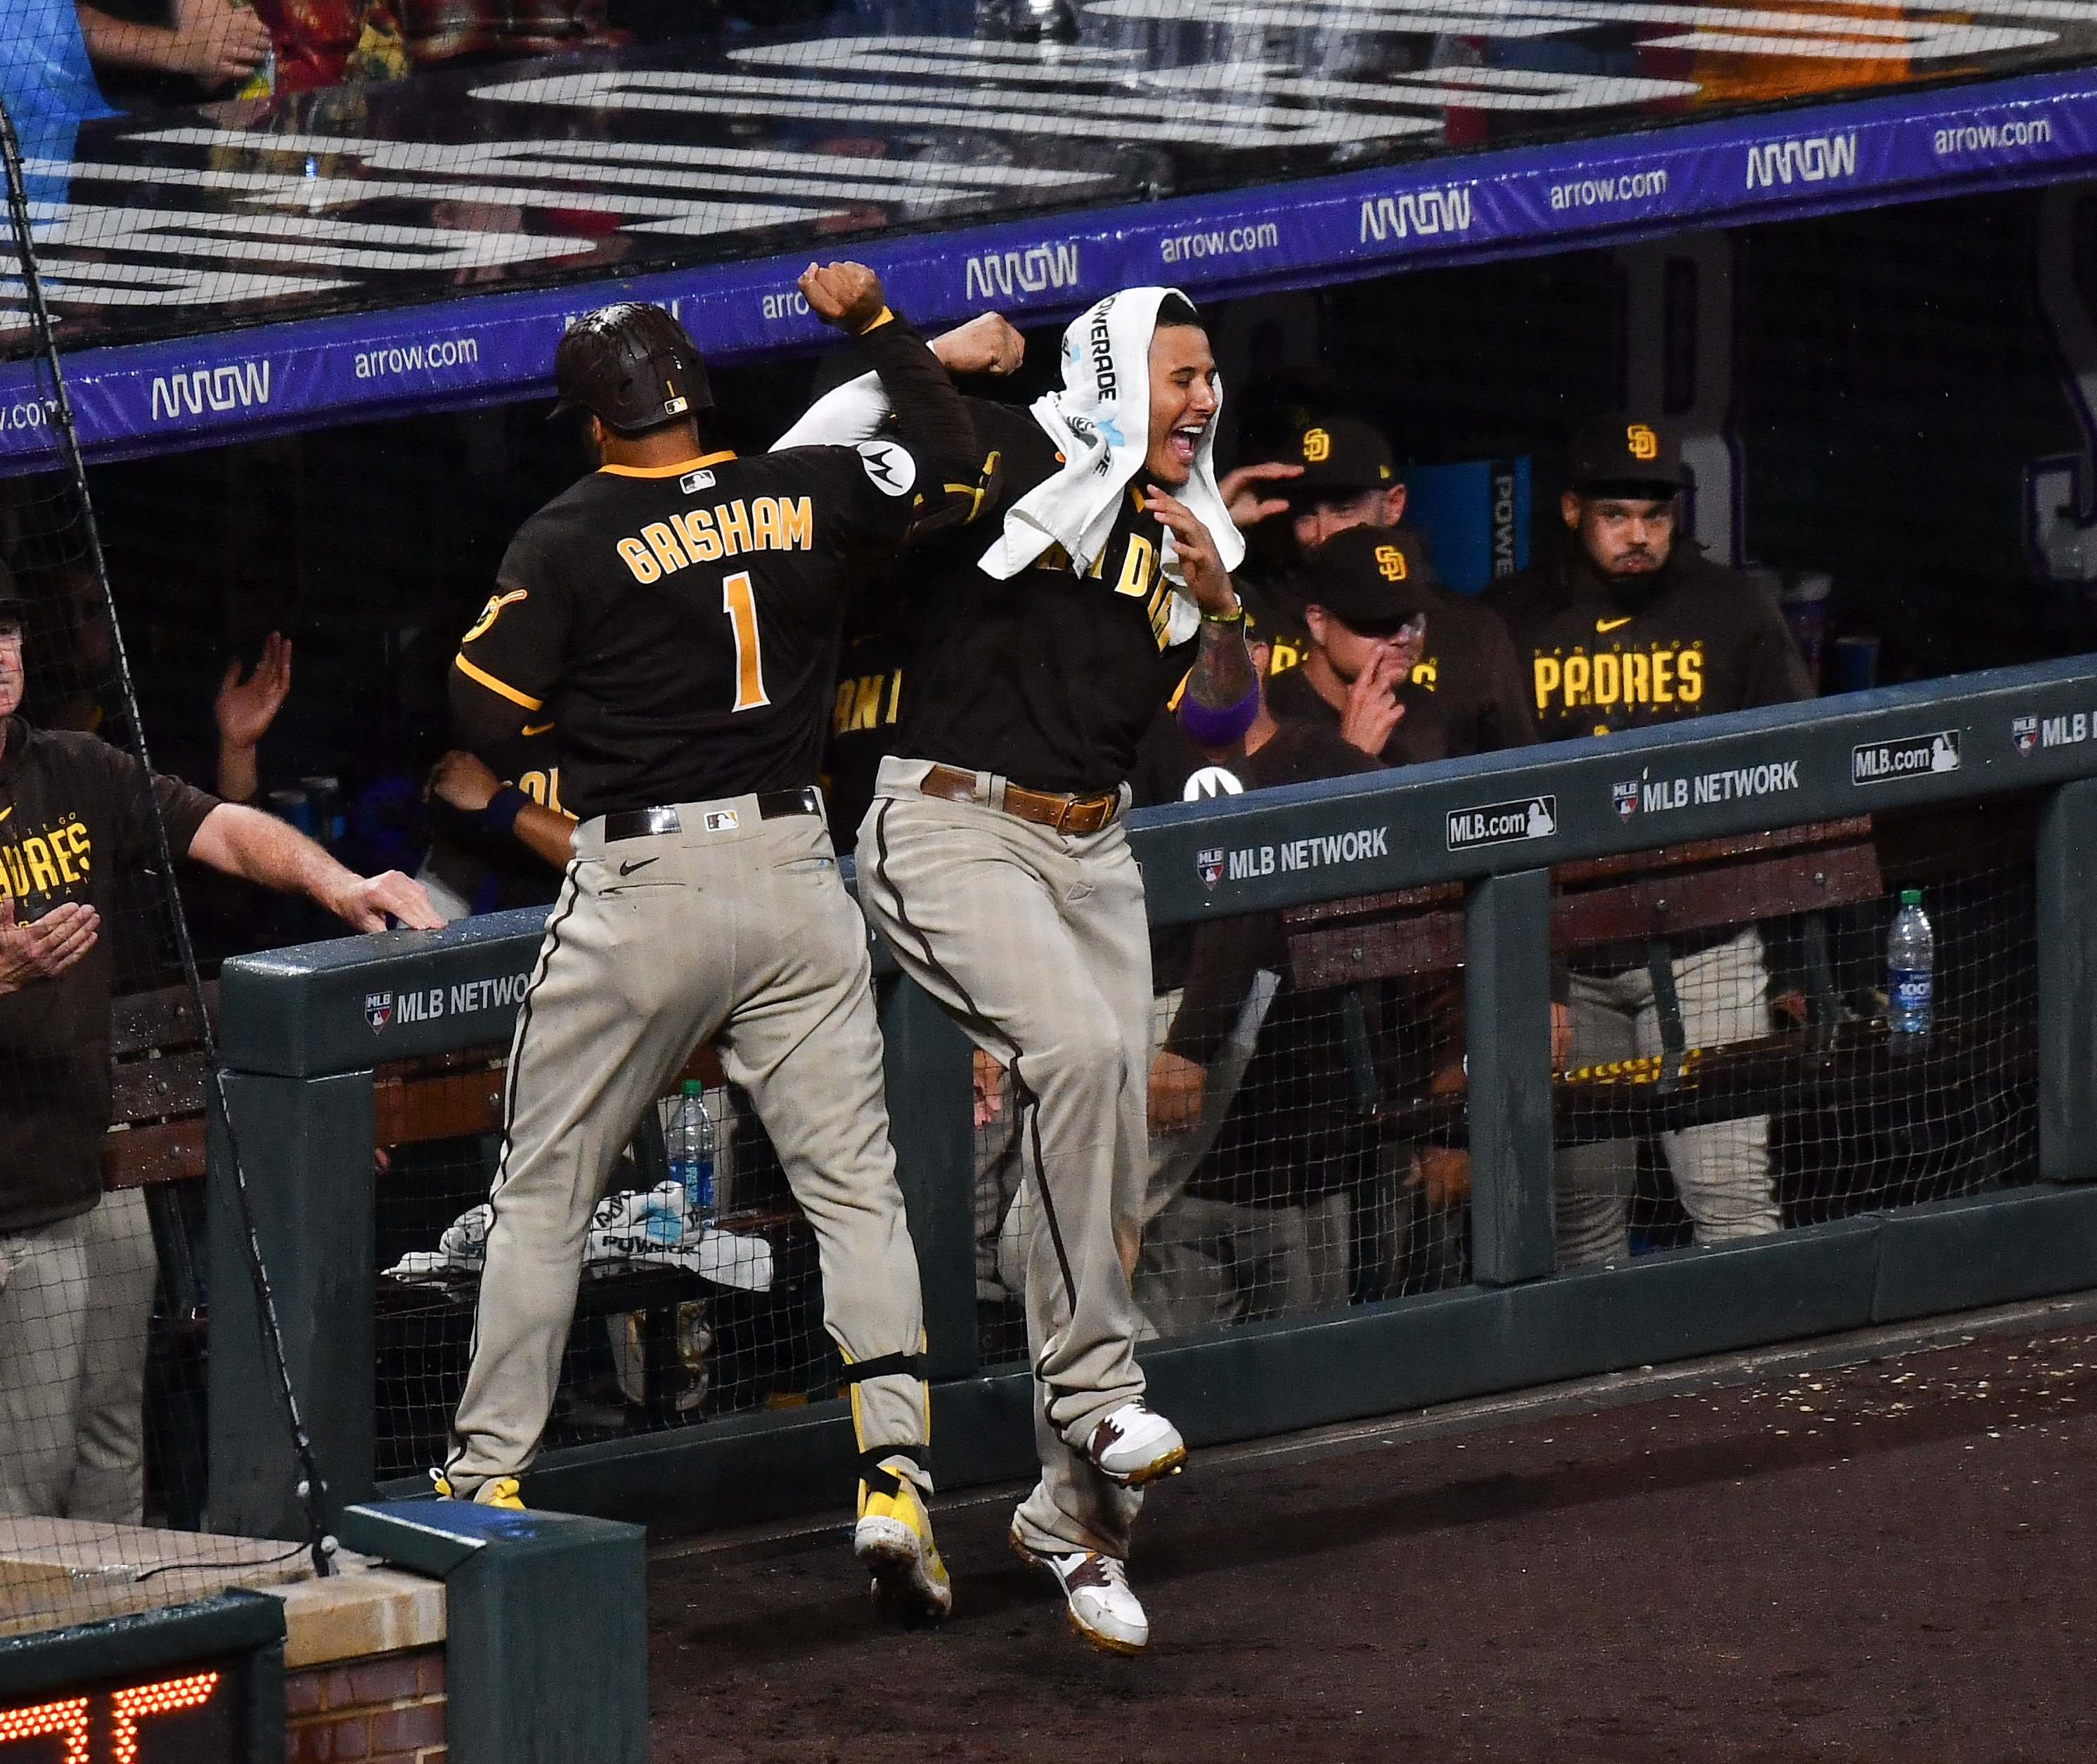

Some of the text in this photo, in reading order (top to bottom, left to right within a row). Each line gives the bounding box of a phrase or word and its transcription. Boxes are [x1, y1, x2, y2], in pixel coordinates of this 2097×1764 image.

[1746, 133, 1857, 190] ARROW
[1935, 120, 2051, 155] arrow.com
[1360, 188, 1471, 243] ARROW
[1551, 169, 1667, 210] arrow.com
[1160, 222, 1278, 264] arrow.com
[966, 243, 1078, 301] ARROW
[355, 337, 478, 379] arrow.com
[1090, 292, 1120, 404] OWERADE
[152, 359, 270, 420] ARROW
[616, 496, 813, 585] GRISHAM
[1495, 475, 1514, 579] POWE
[722, 571, 771, 713] 1
[1533, 650, 1703, 709] PADRES
[2042, 713, 2087, 748] MLB
[1643, 760, 1800, 813] MLB NETWORK
[1856, 747, 1930, 777] MLB.com
[1229, 826, 1389, 880] MLB NETWORK
[1450, 813, 1525, 844] MLB.com
[396, 972, 535, 1024] MLB NETWO
